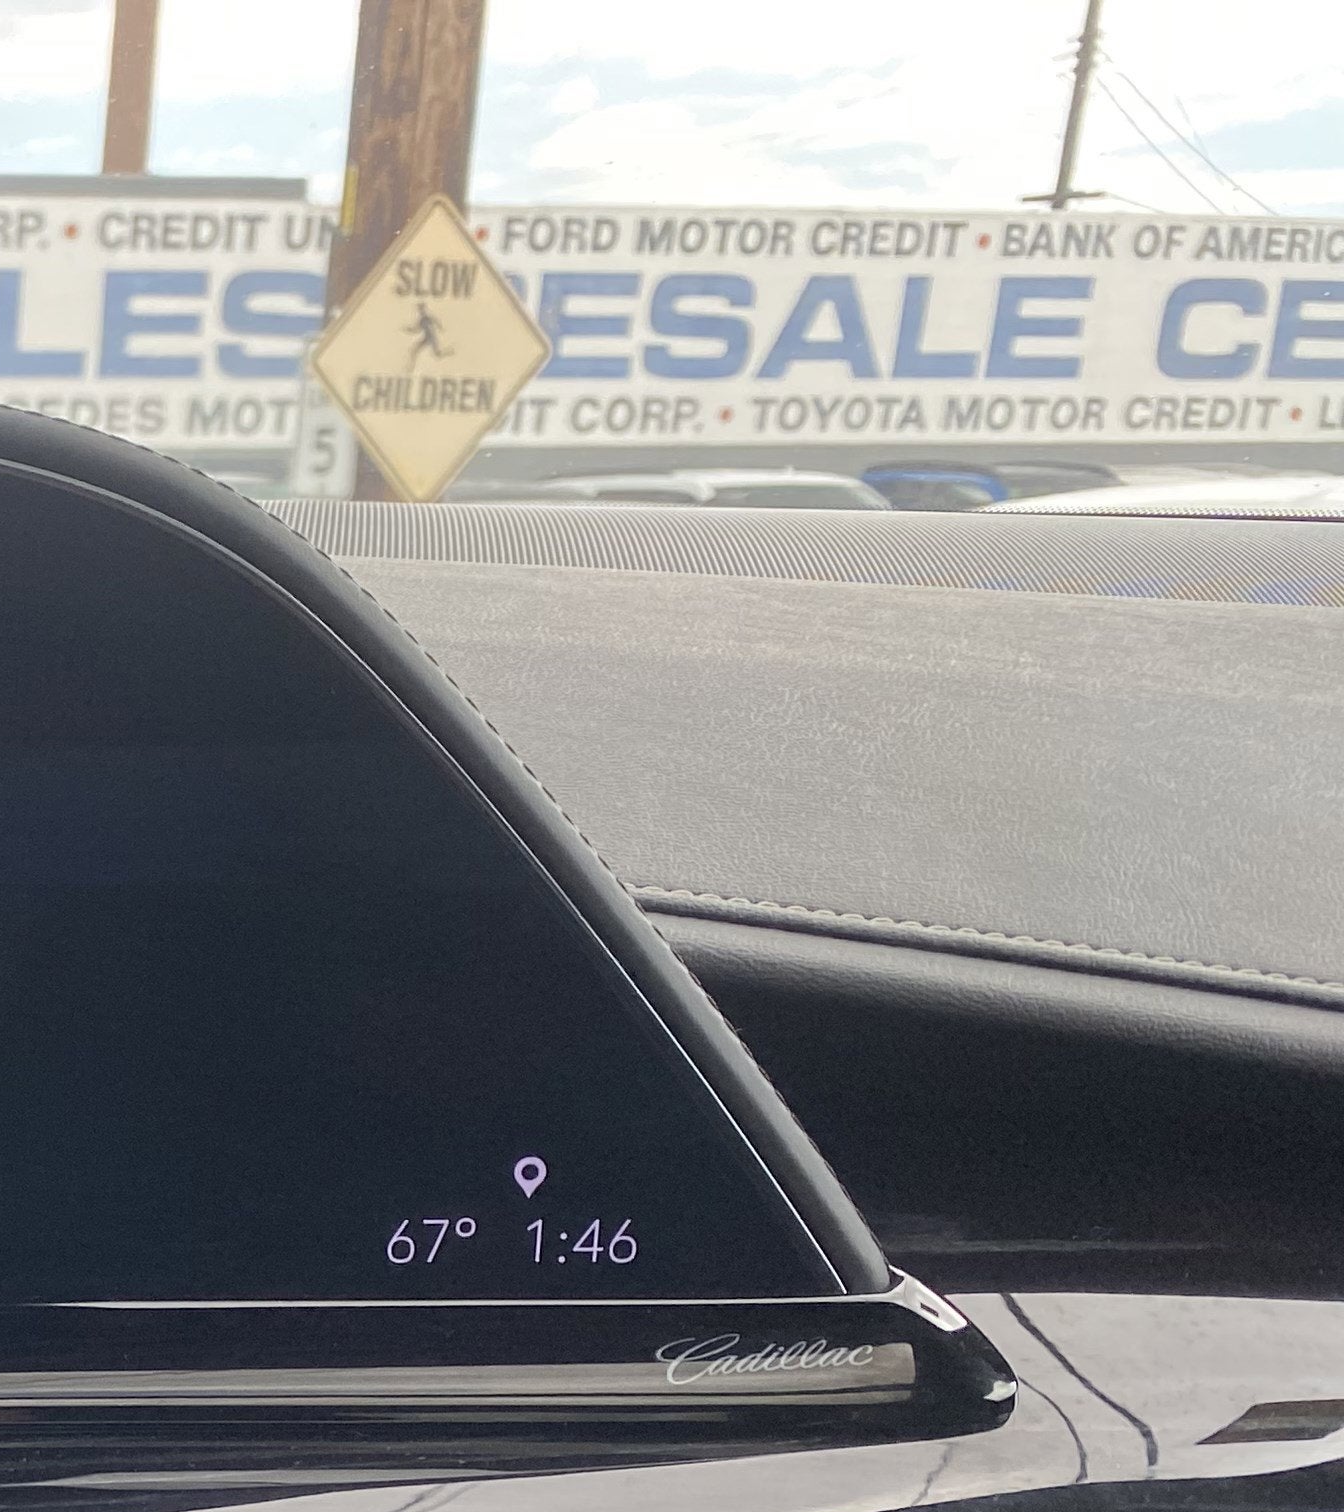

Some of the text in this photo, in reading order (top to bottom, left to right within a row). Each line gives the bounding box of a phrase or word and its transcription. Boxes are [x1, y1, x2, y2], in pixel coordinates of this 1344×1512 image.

[99, 211, 267, 252] CREDIT
[501, 216, 968, 259] FORD MOTOR CREDIT
[1000, 222, 1116, 259] BANK
[1132, 225, 1186, 260] OF
[396, 259, 479, 299] SLOW
[505, 271, 1096, 379] ESALE
[354, 374, 496, 414] CHILDREN
[1318, 395, 1344, 430] L
[570, 398, 704, 435] CORP.
[752, 396, 1282, 434] TOYOTA MOTOR CREDIT
[526, 1217, 638, 1264] 1:46
[655, 1333, 875, 1385] Cadillac
